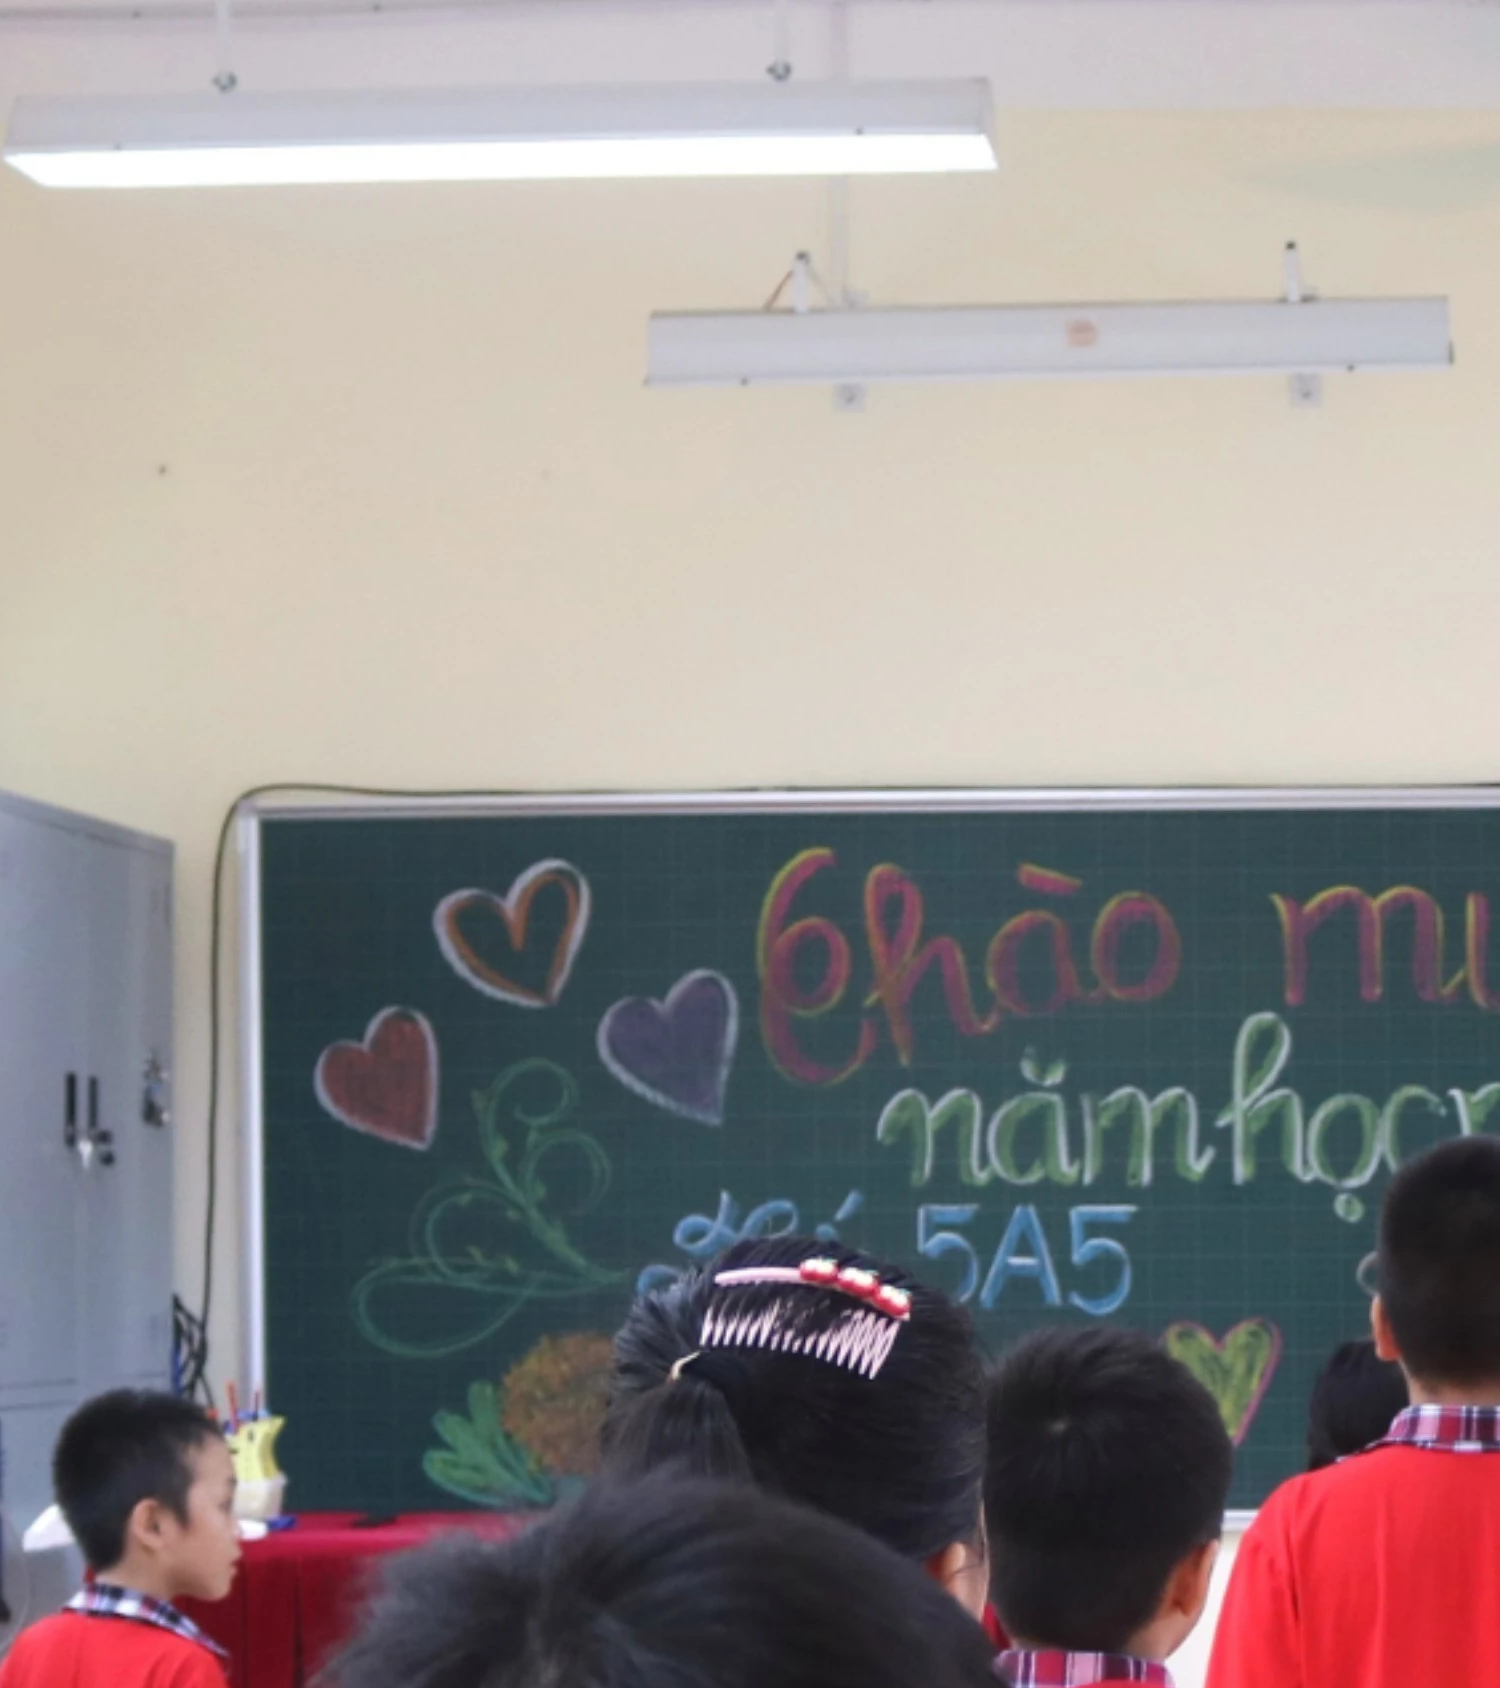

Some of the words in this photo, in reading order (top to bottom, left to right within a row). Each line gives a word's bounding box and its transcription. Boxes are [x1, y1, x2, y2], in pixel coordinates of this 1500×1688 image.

[757, 846, 1182, 1086] Chào
[876, 1044, 1214, 1187] năm
[1215, 1011, 1448, 1222] học
[916, 1202, 1140, 1316] 5A5
